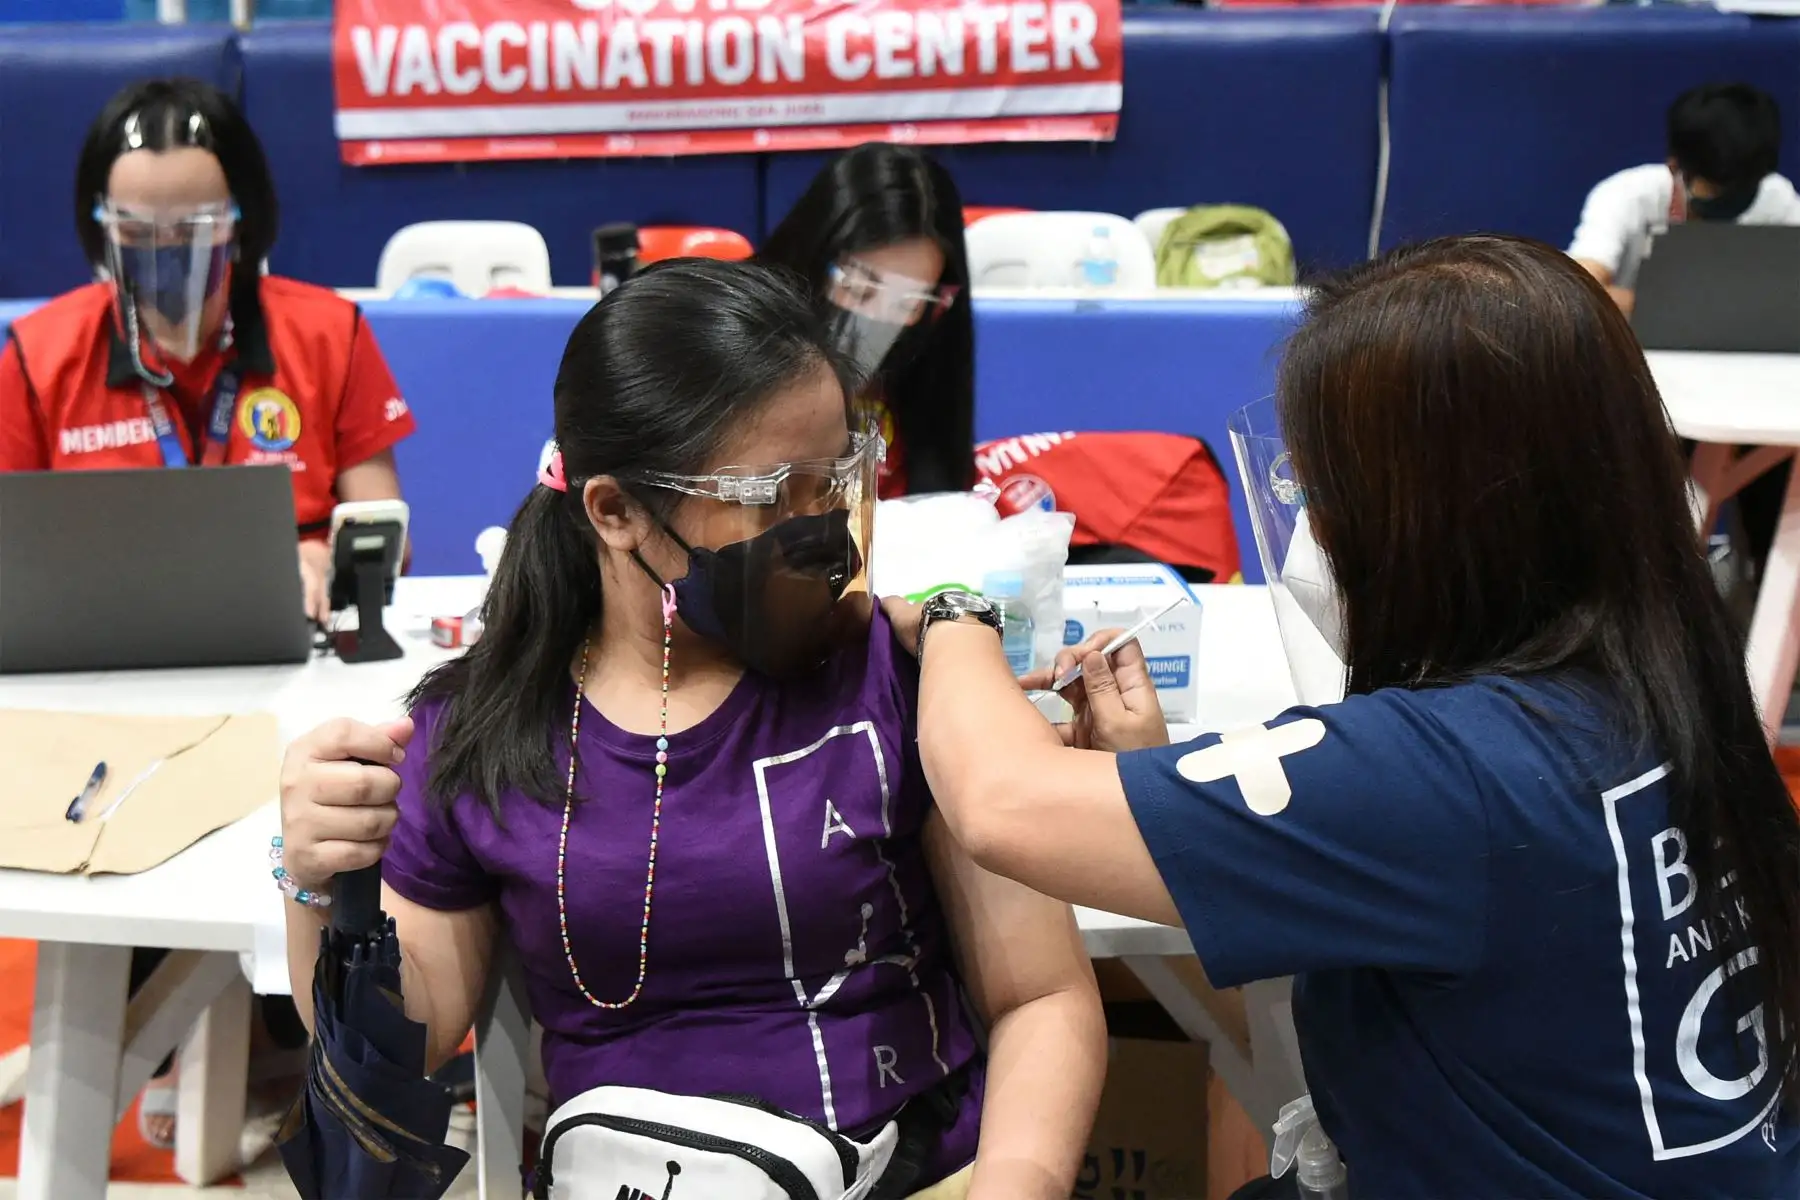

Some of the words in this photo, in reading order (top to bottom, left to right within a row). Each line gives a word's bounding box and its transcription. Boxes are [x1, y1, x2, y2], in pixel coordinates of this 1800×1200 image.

[353, 20, 805, 96] VACCINATION
[825, 2, 1100, 80] CENTER
[1146, 661, 1187, 674] YRINGE
[821, 799, 857, 849] A
[873, 1045, 905, 1088] R
